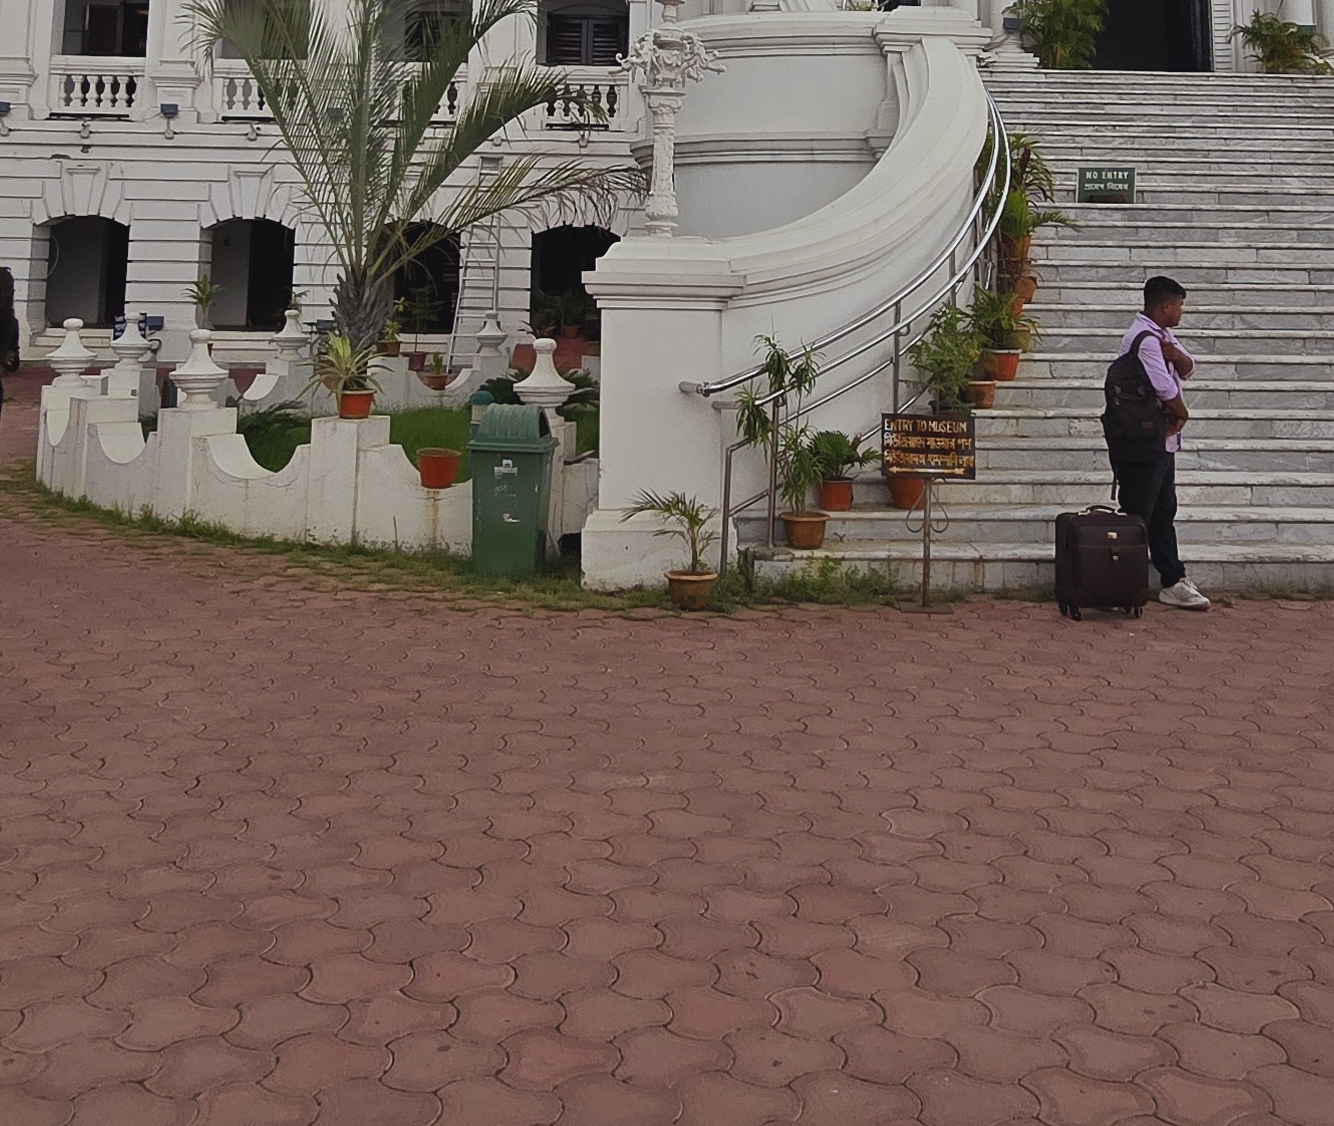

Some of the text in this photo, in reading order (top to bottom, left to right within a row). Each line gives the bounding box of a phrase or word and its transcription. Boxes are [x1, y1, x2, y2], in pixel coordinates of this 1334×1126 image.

[1085, 171, 1129, 179] NO ENTRY
[884, 418, 967, 433] ENTRY TO MUSEUM
